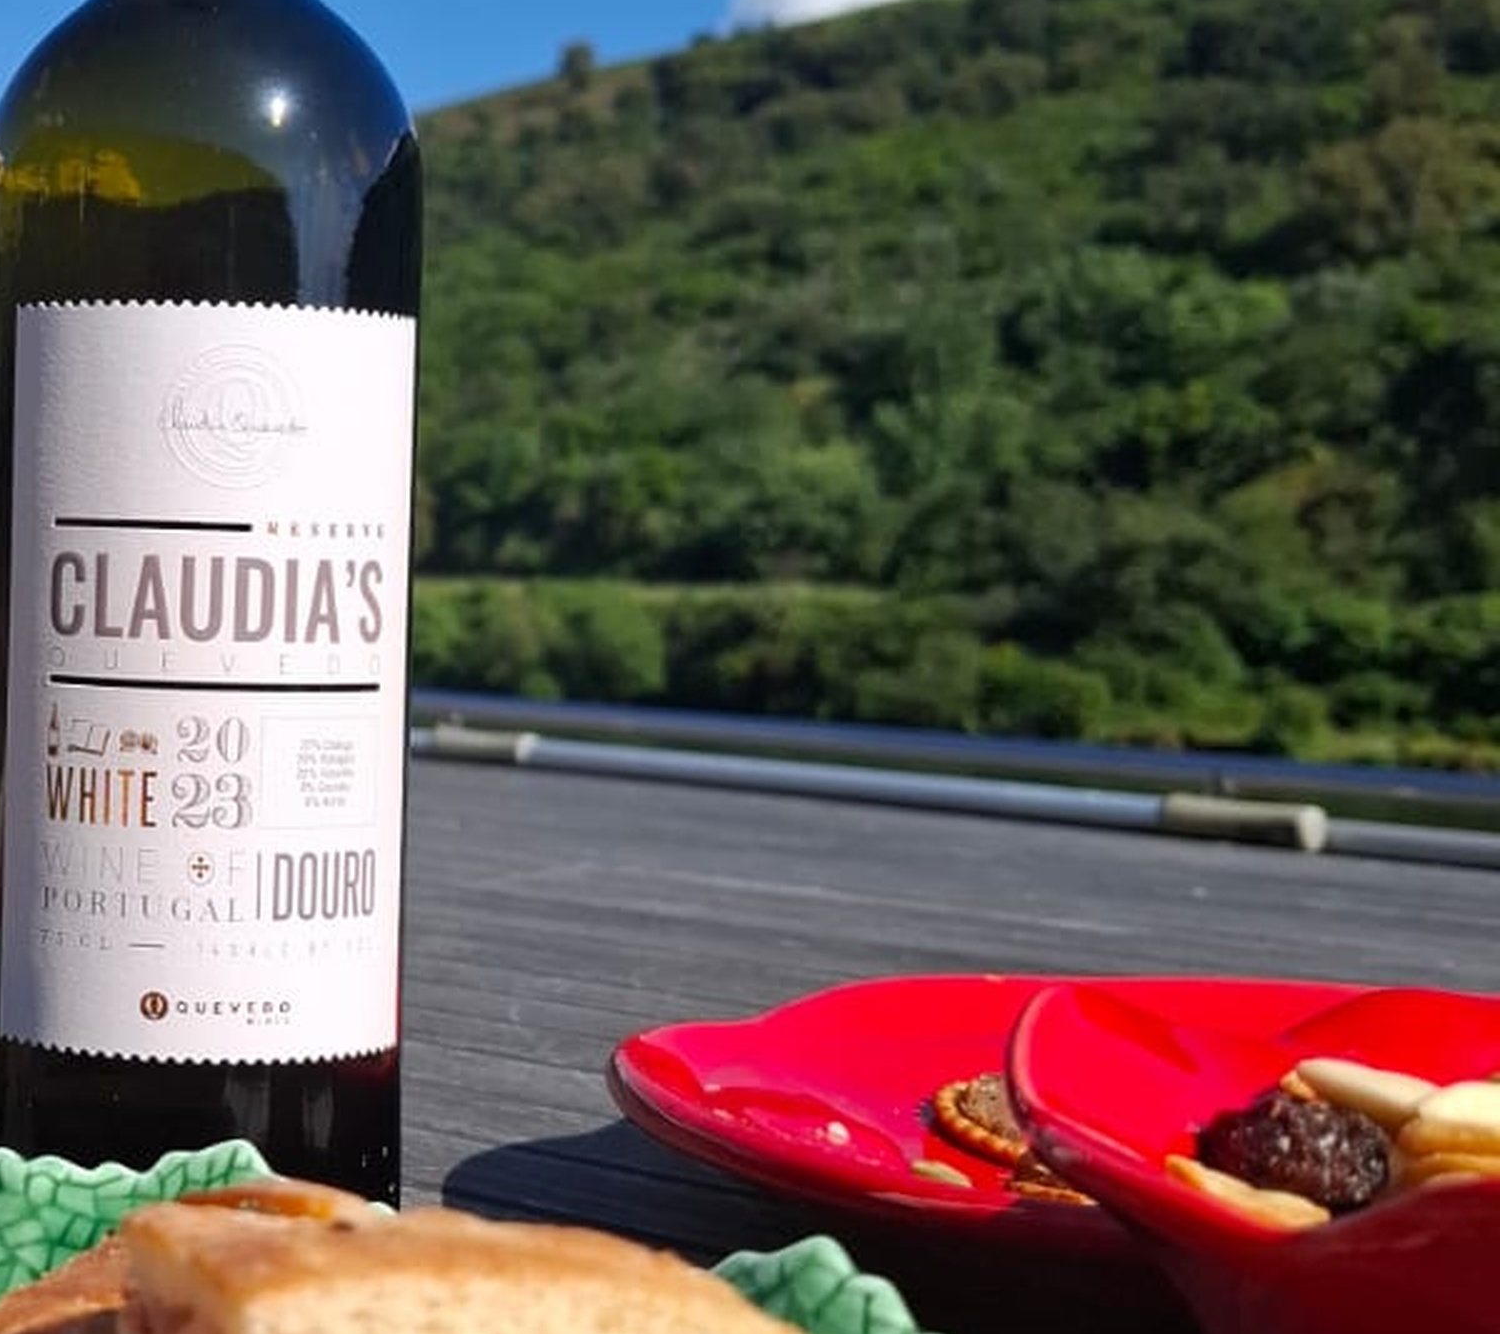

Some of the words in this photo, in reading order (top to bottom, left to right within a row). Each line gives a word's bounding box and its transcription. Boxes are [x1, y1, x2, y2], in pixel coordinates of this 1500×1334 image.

[50, 551, 384, 645] CLAUDIA'S
[50, 645, 382, 676] QUEVEDO
[176, 714, 250, 765] 20
[45, 764, 157, 828] WHITE
[171, 772, 253, 830] 23
[40, 840, 160, 884] WINE
[272, 847, 376, 922] DOURO
[40, 886, 244, 924] PORTUGAL
[176, 999, 292, 1016] QUEVEDO
